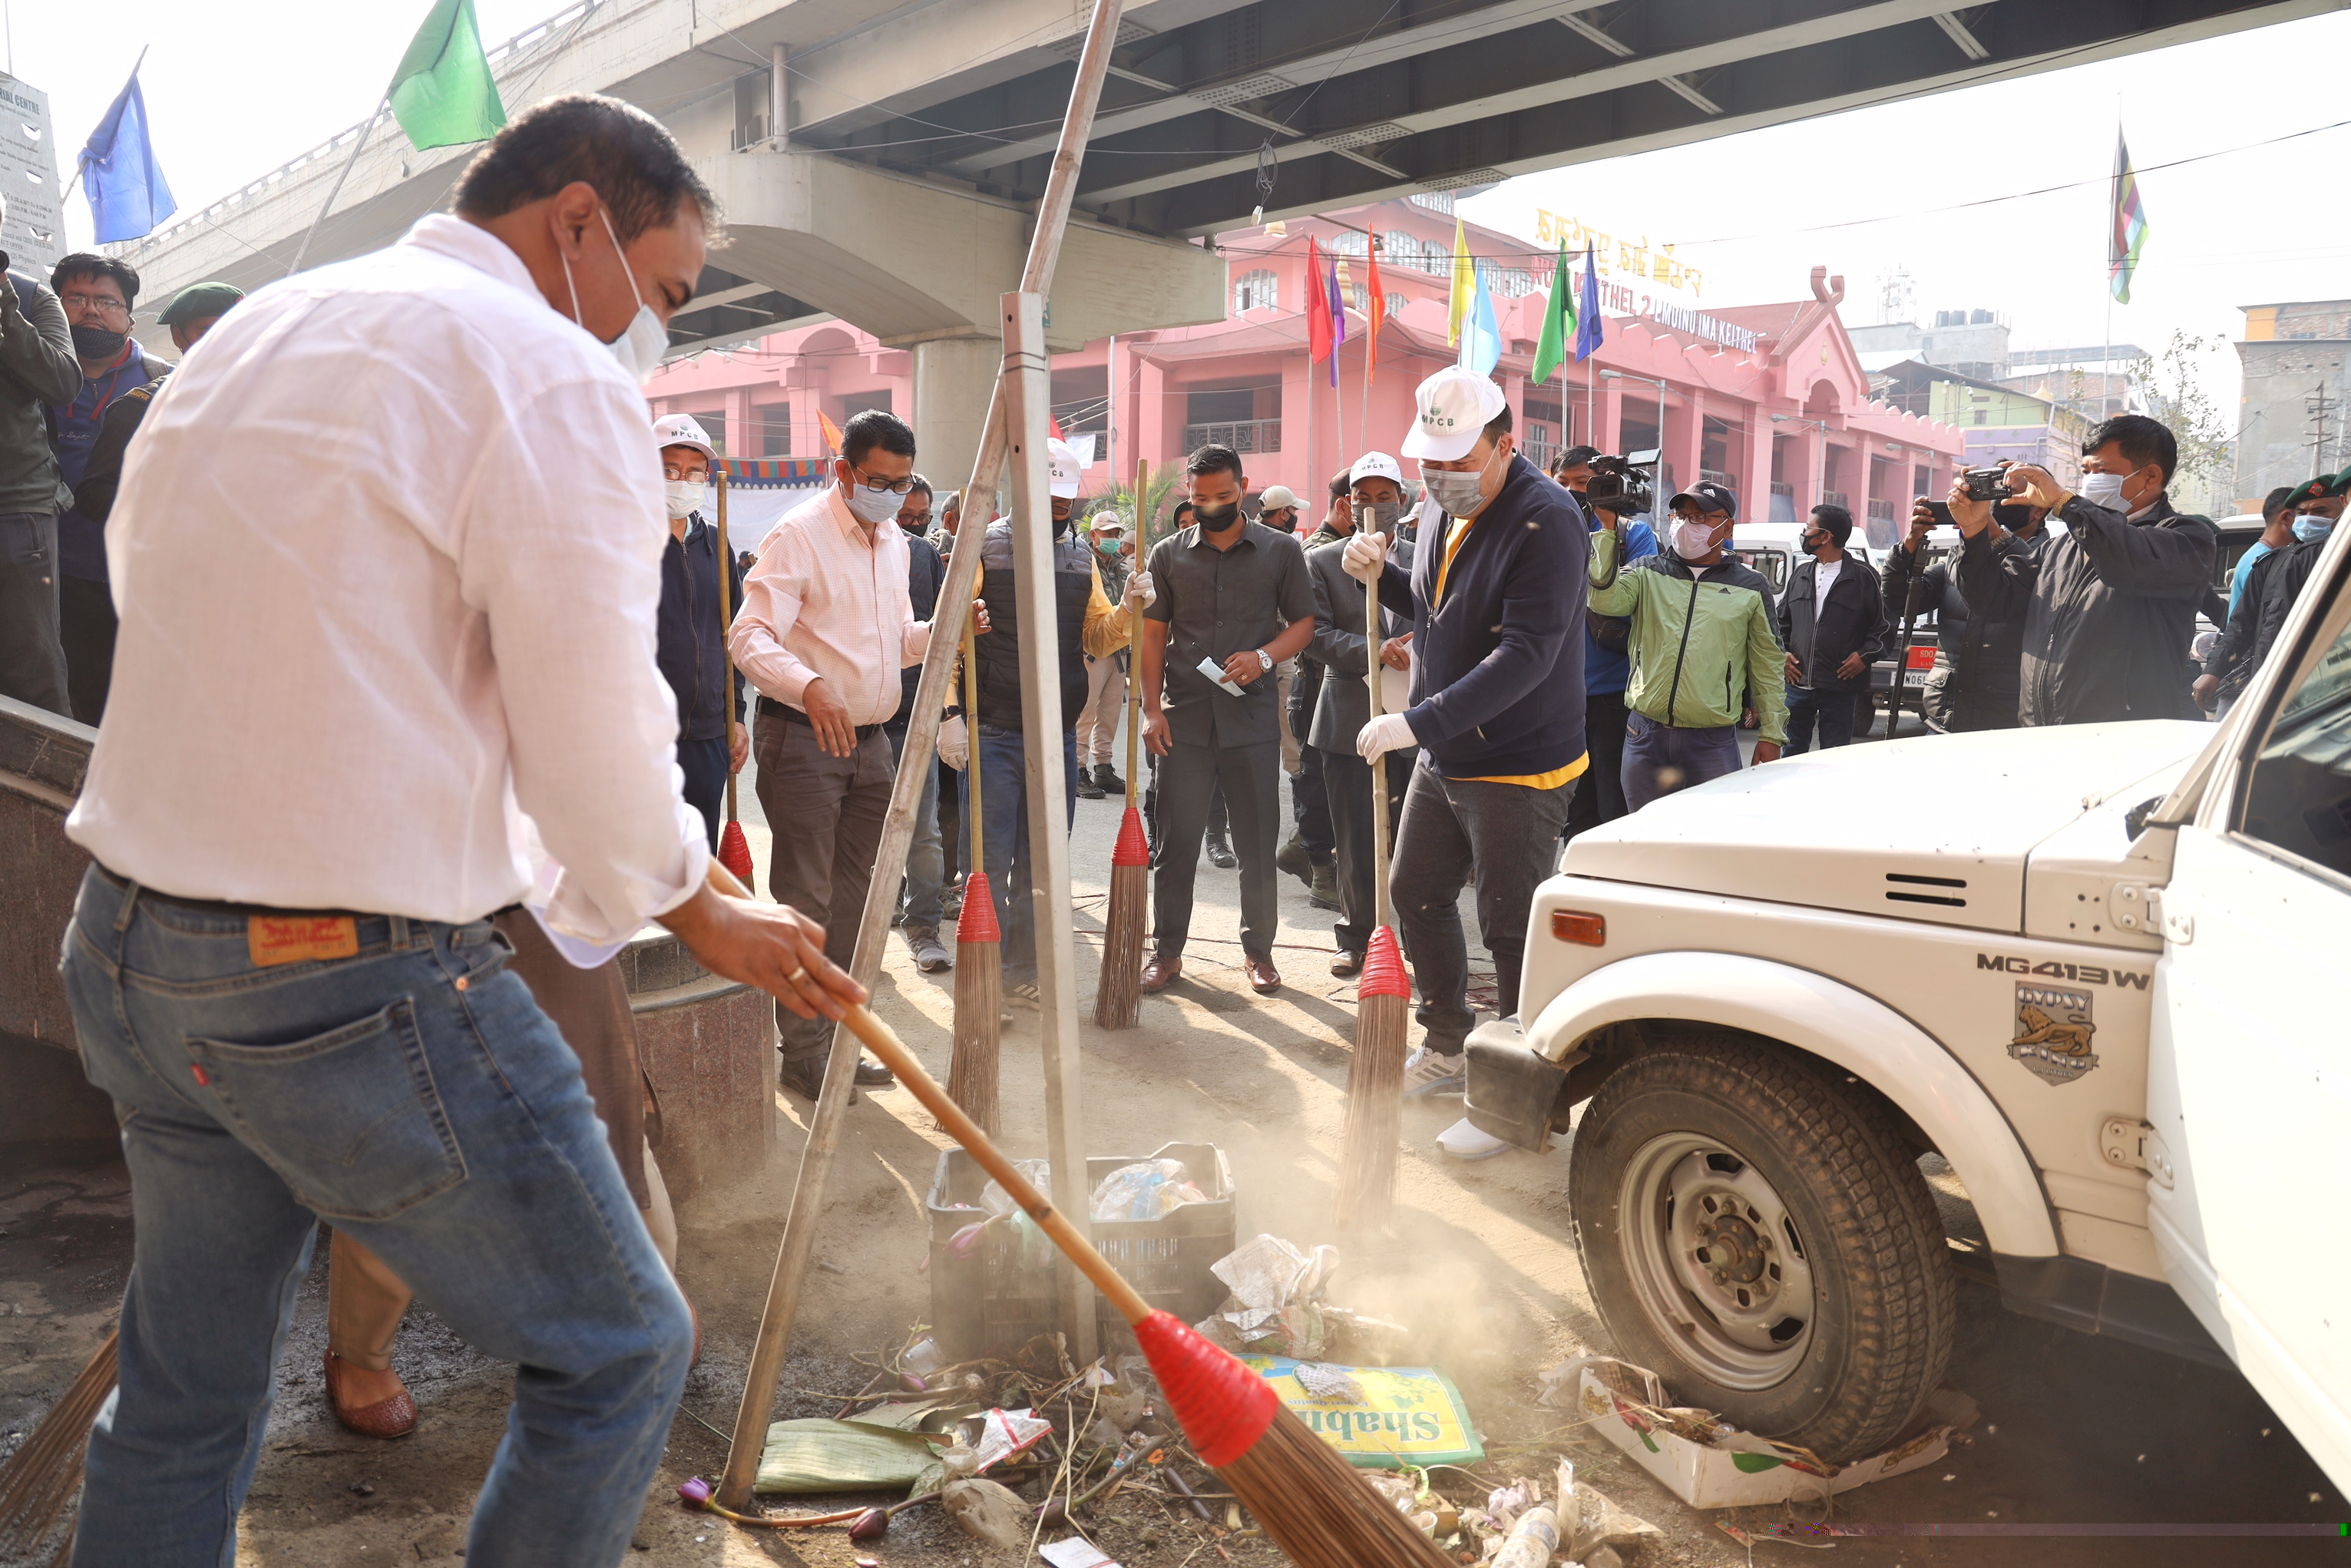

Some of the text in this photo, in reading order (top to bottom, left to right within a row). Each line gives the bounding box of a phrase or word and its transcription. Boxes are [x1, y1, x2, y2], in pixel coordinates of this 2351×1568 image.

[15, 94, 40, 115] CENTRE
[18, 254, 37, 265] Physics
[1642, 295, 1653, 319] 2
[1654, 299, 1757, 355] EMOINU IMA KEITHEL
[1421, 414, 1454, 427] MPCB
[671, 430, 699, 440] MPCB
[2018, 987, 2090, 1011] GYPSY
[2019, 1045, 2086, 1070] KING
[2045, 1067, 2075, 1080] LITRES
[1287, 1398, 1328, 1407] Quality
